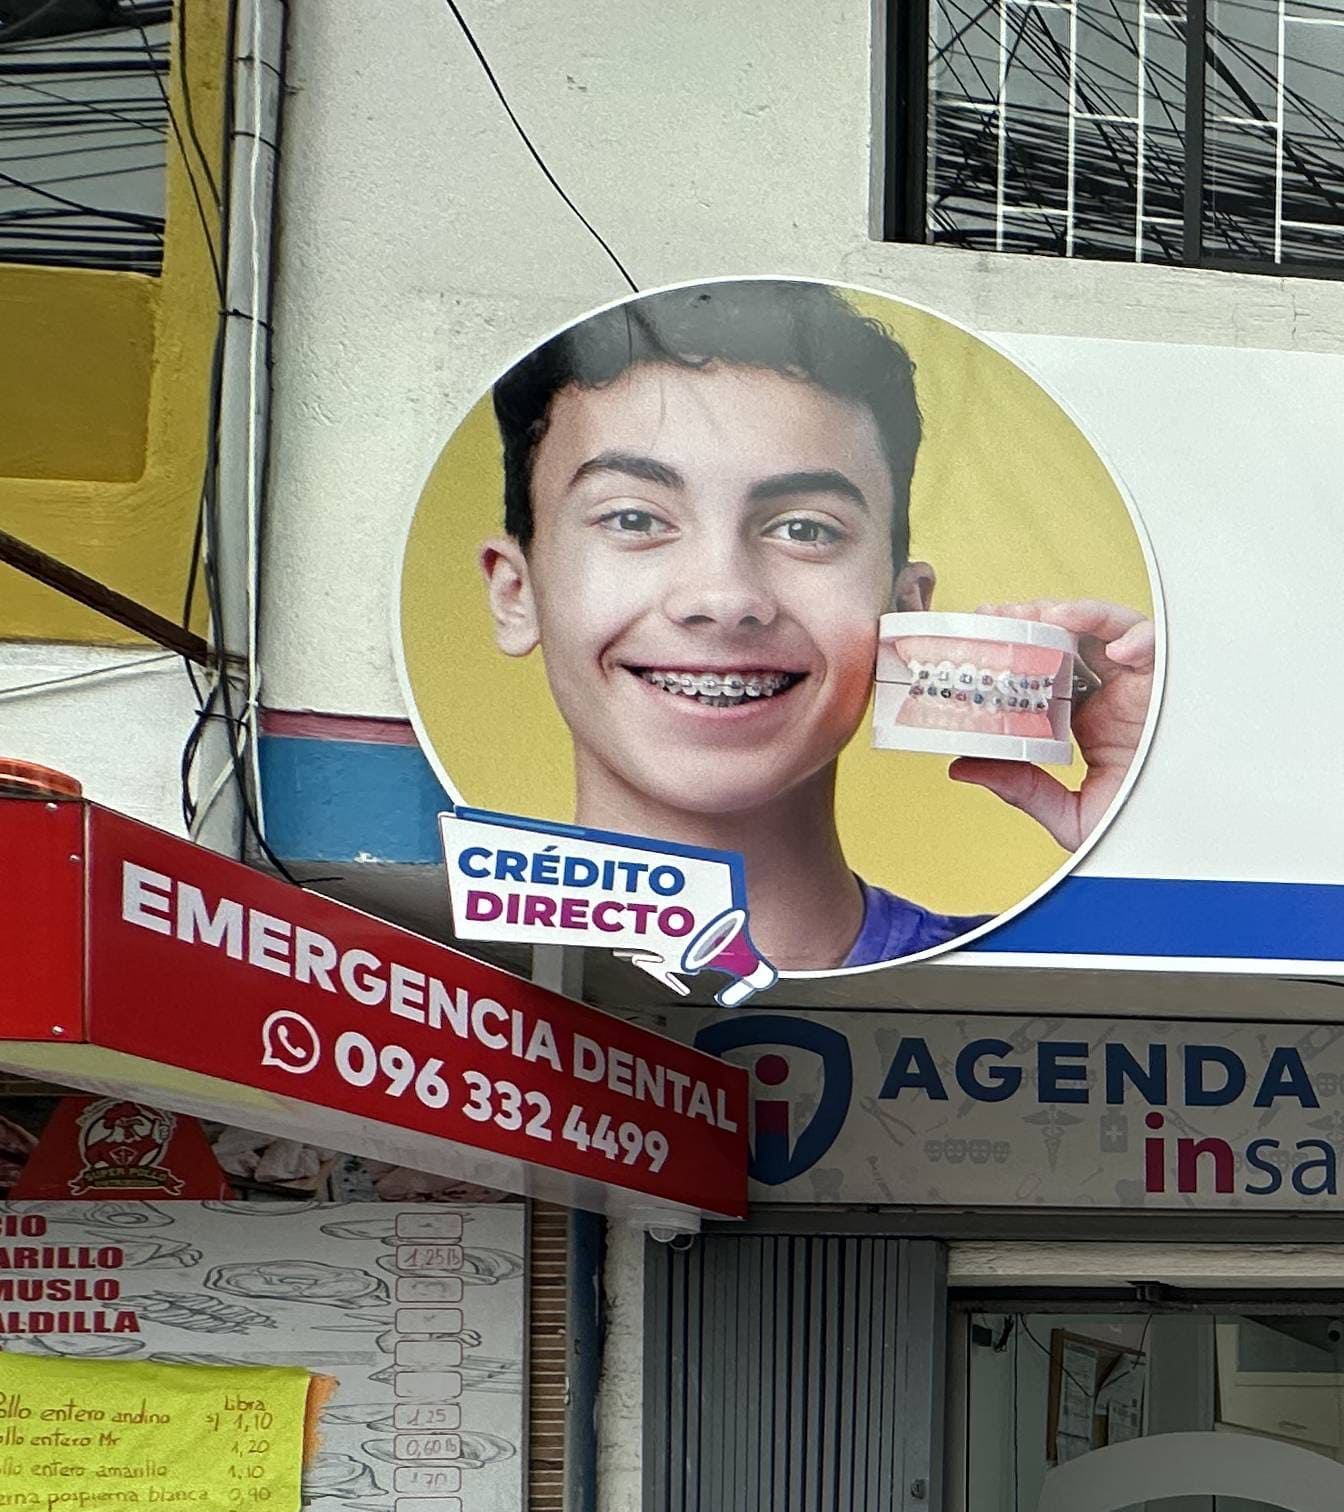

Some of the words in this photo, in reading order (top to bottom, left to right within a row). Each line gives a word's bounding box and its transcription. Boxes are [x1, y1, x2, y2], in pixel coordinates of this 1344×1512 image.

[459, 845, 686, 897] CRÉDITO
[466, 890, 696, 938] DIRECTO
[121, 860, 561, 1072] EMERGENCIA
[573, 1029, 739, 1133] DENTAL
[878, 1036, 1320, 1108] AGENDA
[335, 1030, 449, 1108] 096
[462, 1070, 553, 1140] 332
[562, 1105, 669, 1173] 4499
[0, 1214, 47, 1237] IO
[0, 1310, 141, 1333] LDILLA
